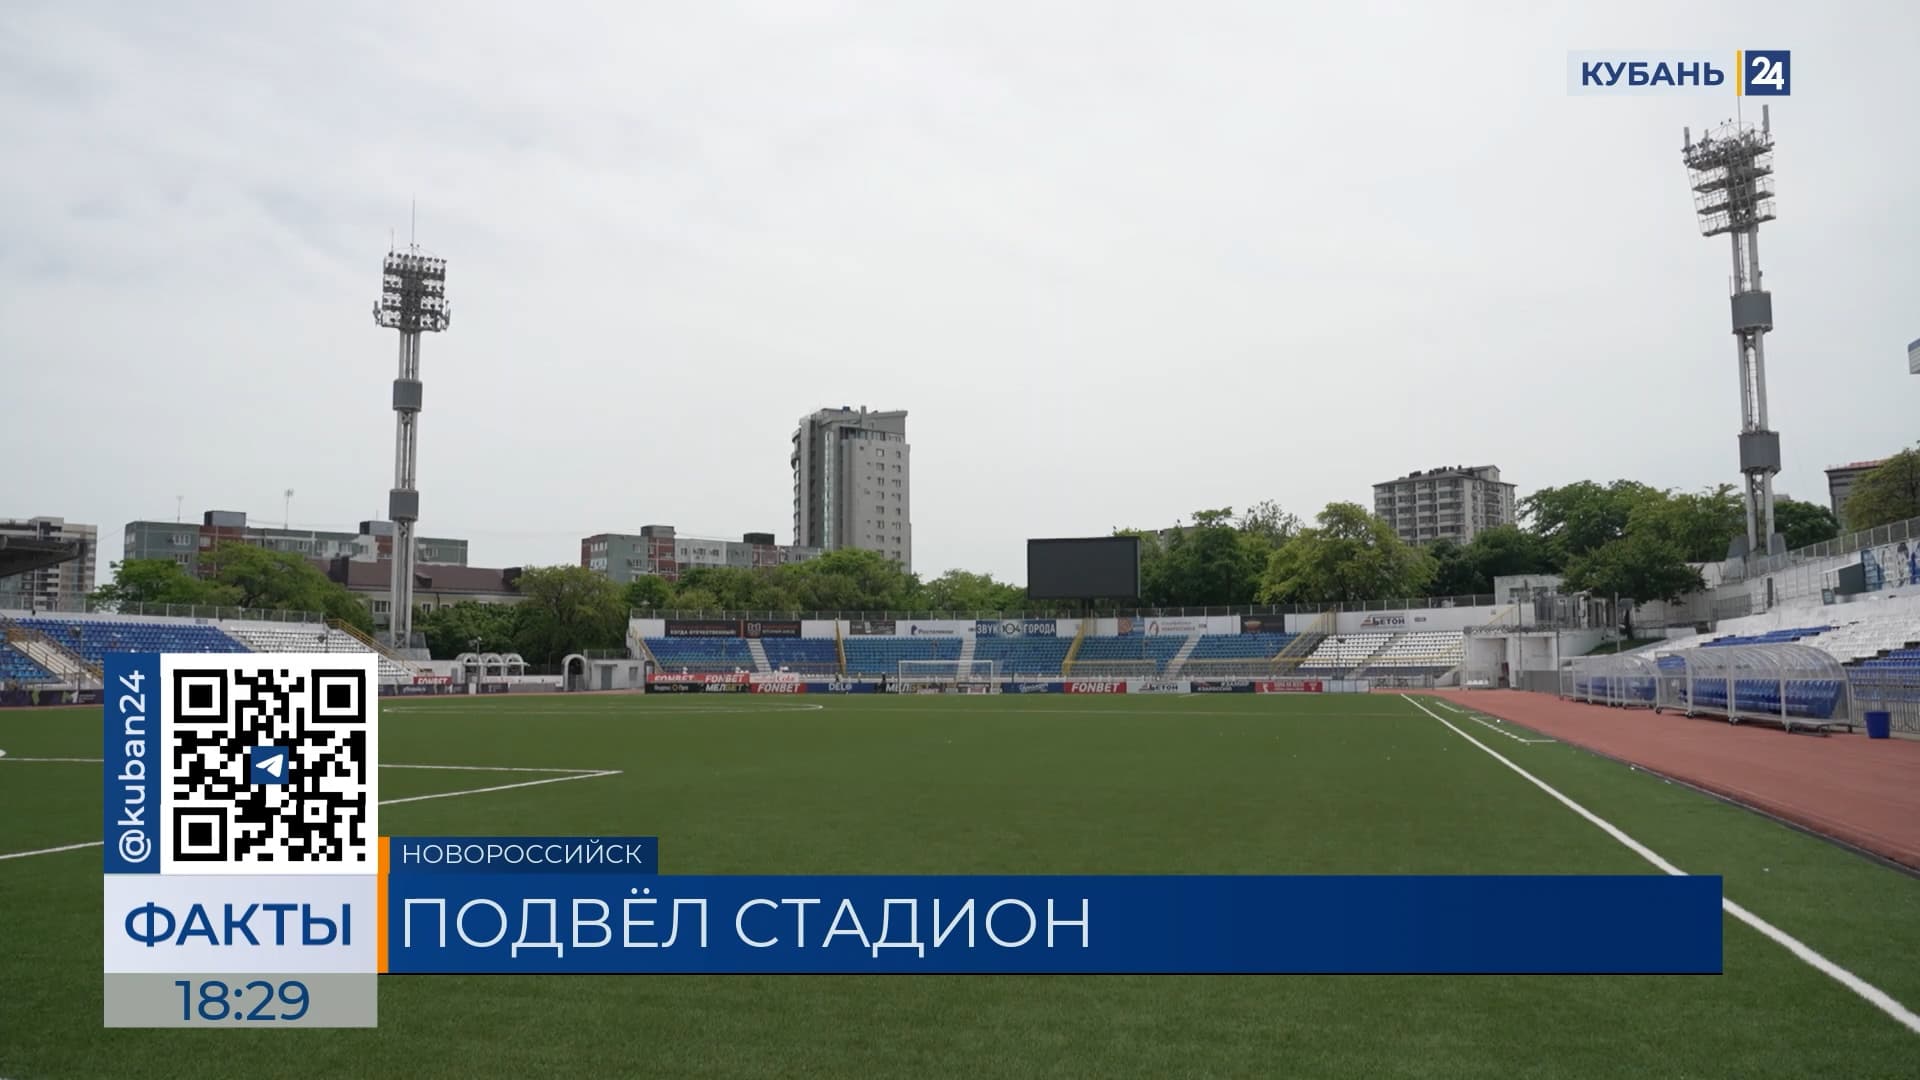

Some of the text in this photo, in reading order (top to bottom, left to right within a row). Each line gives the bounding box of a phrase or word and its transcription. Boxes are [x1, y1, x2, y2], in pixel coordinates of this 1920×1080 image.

[1023, 623, 1056, 634] ГОРОДА
[704, 673, 744, 683] FONBET
[757, 683, 801, 693] FONBET
[1071, 682, 1120, 693] FONBET
